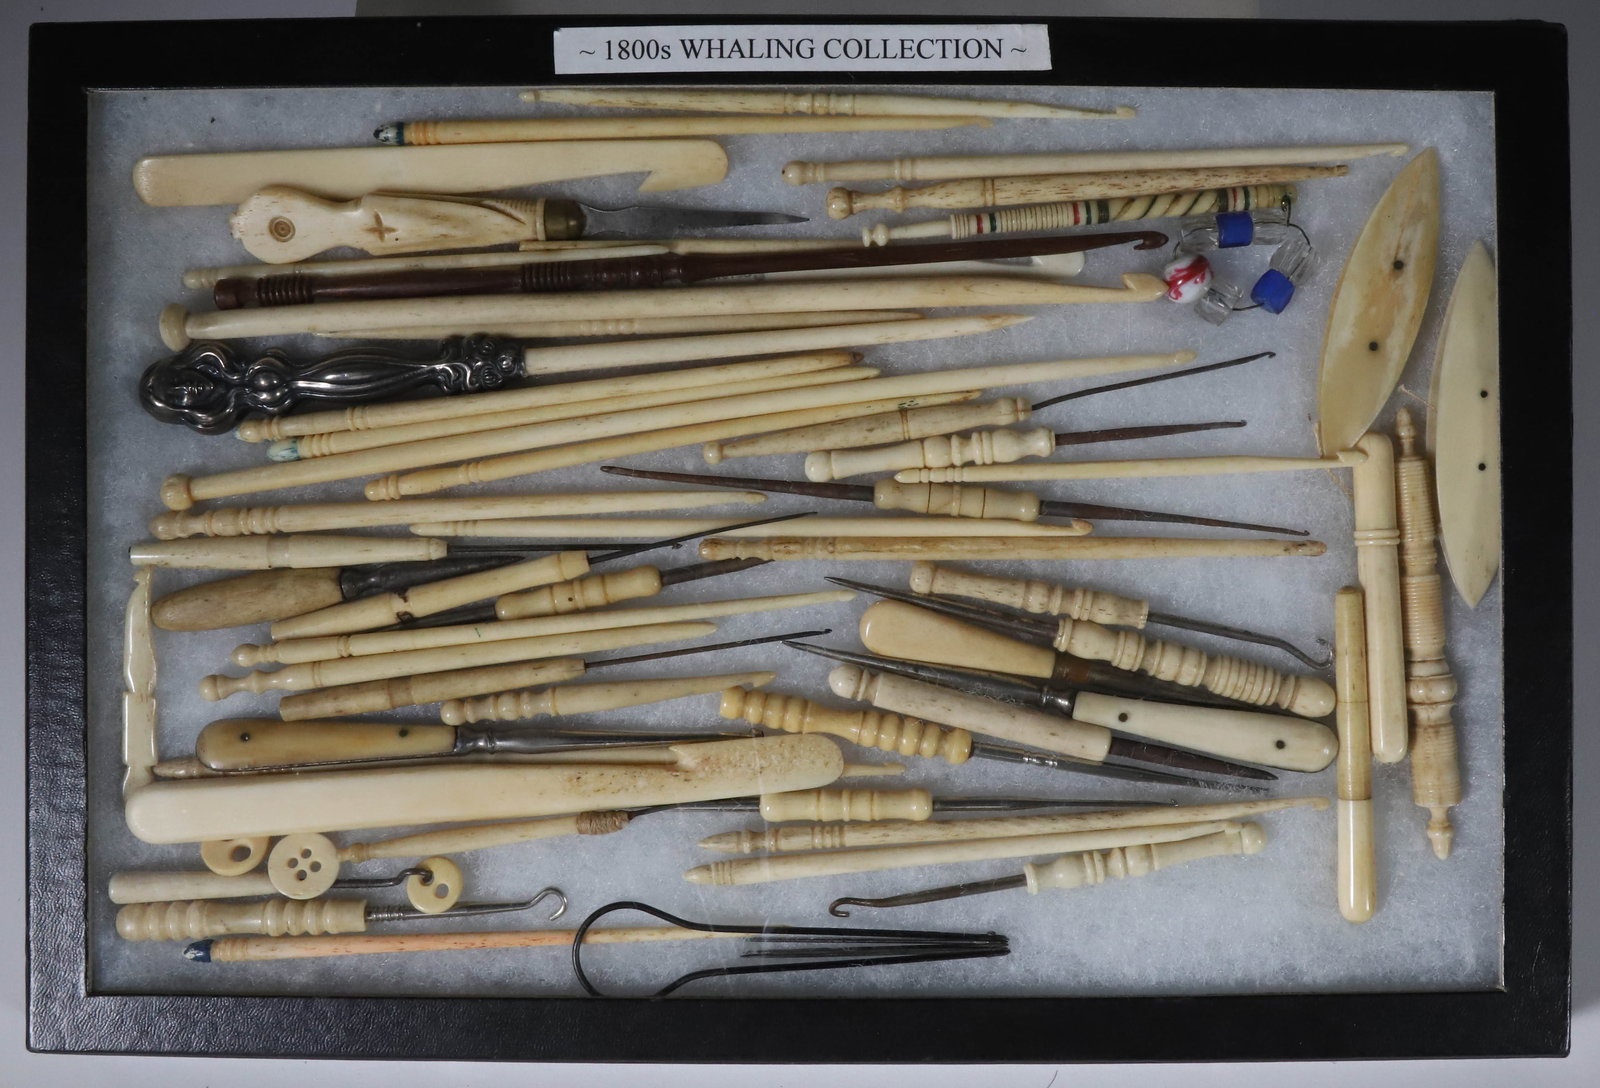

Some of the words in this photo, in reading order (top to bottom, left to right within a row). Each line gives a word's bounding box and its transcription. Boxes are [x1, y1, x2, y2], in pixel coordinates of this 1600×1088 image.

[604, 38, 672, 61] 1800s
[679, 38, 817, 60] WHALING
[822, 37, 1005, 60] COLLECTION
